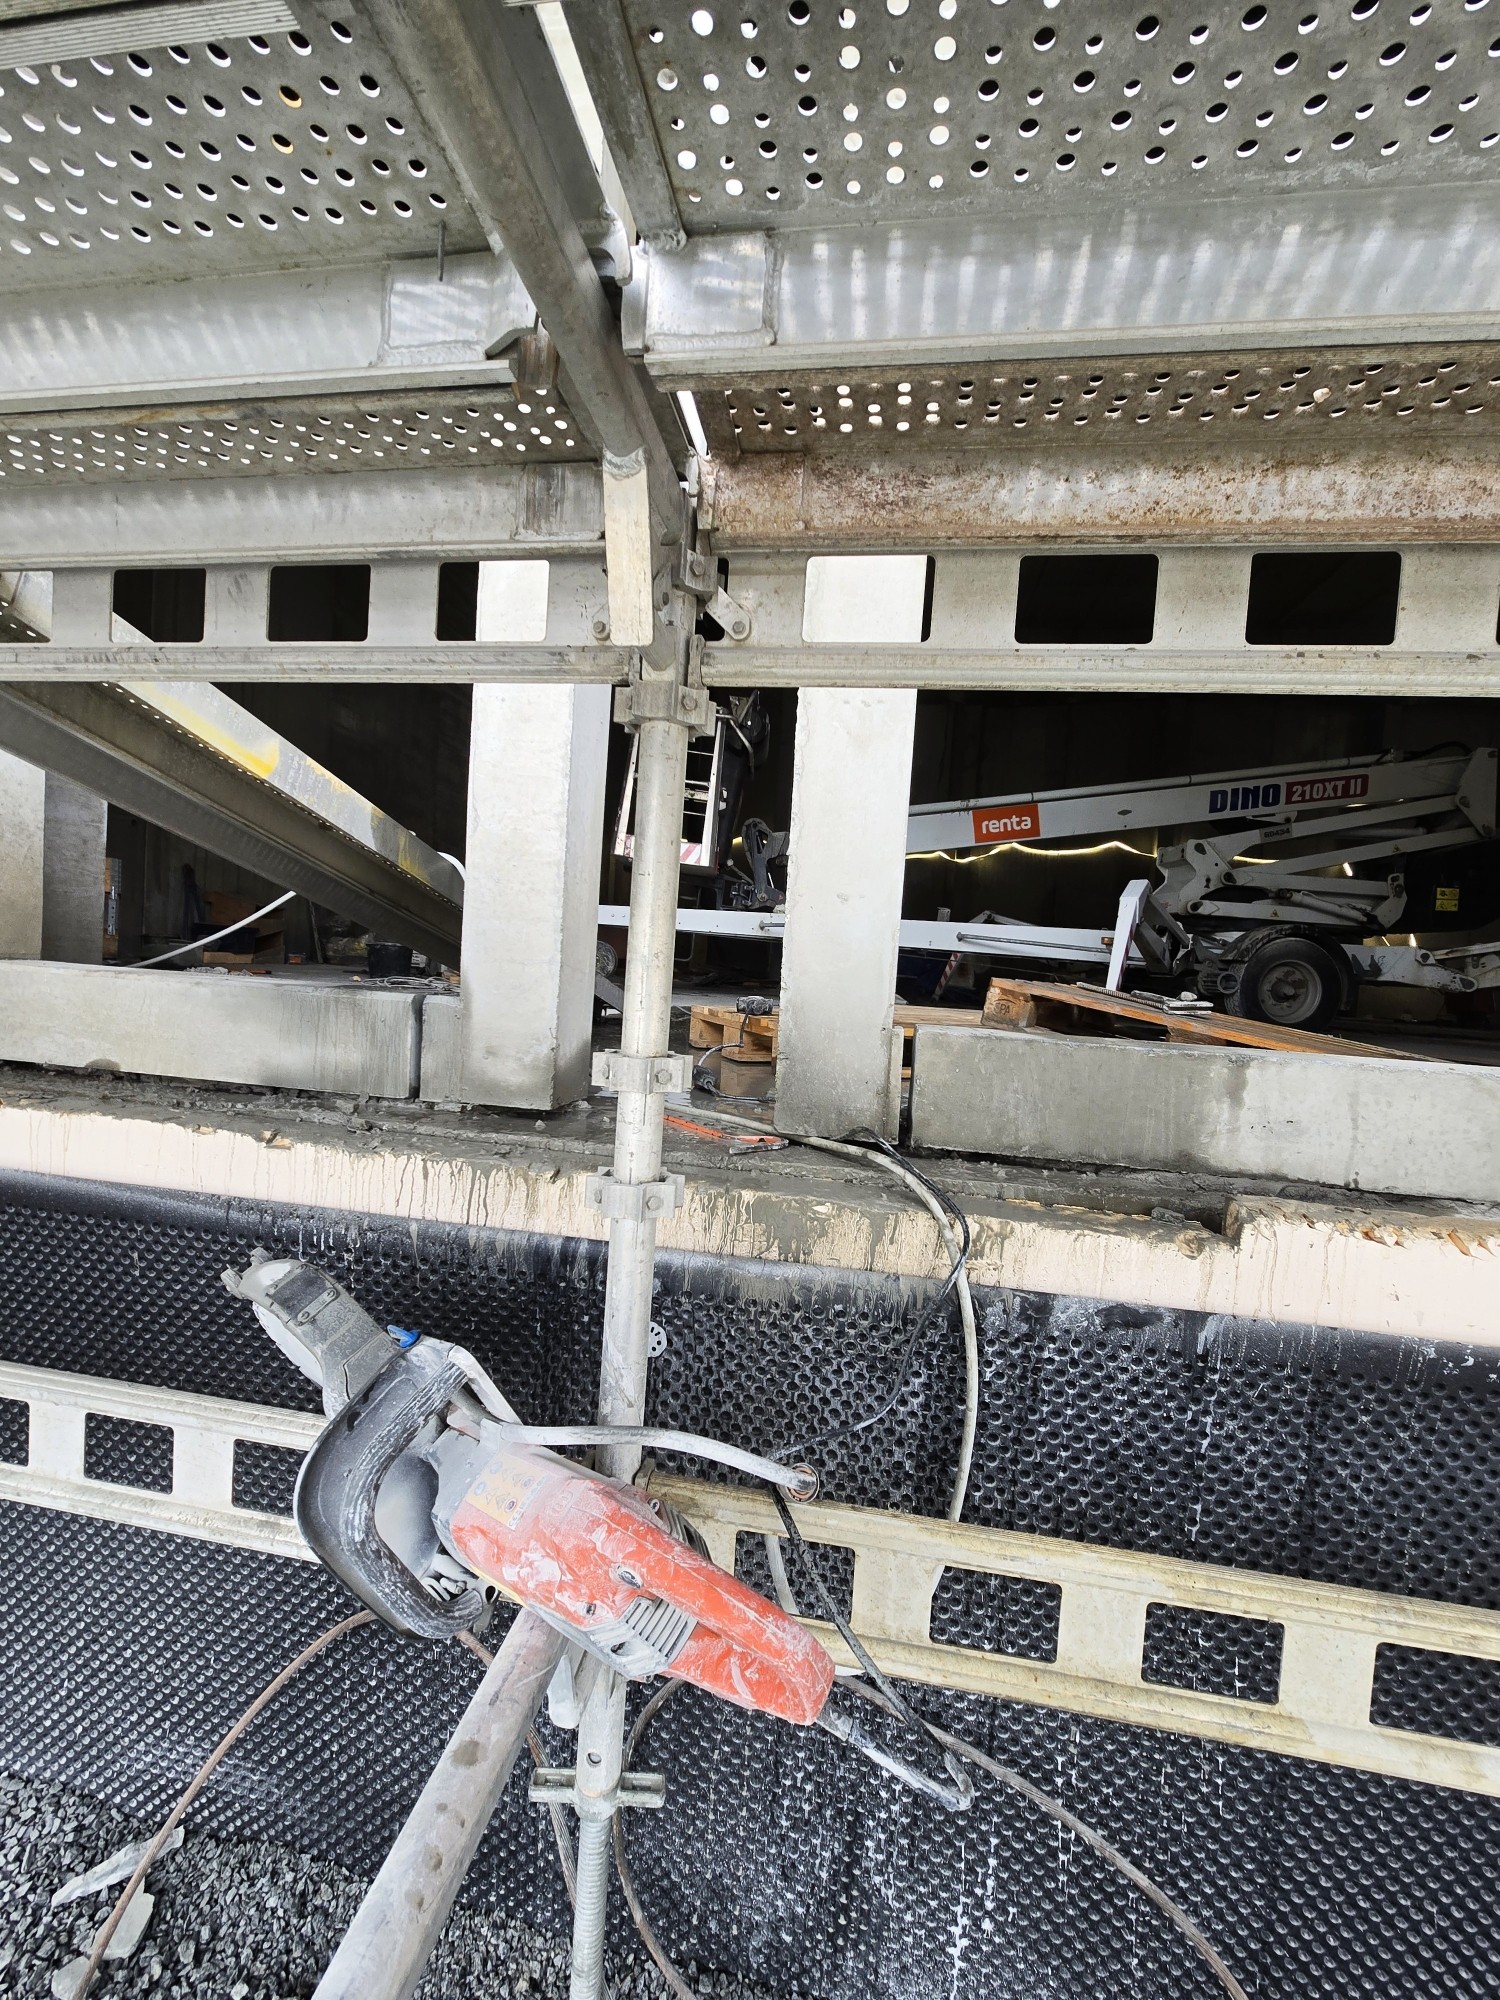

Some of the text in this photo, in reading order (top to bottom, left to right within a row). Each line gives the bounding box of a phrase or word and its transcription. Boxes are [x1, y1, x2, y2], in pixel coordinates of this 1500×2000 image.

[1209, 784, 1281, 813] DINO
[1291, 780, 1345, 801] 210XT
[981, 815, 1032, 834] renta
